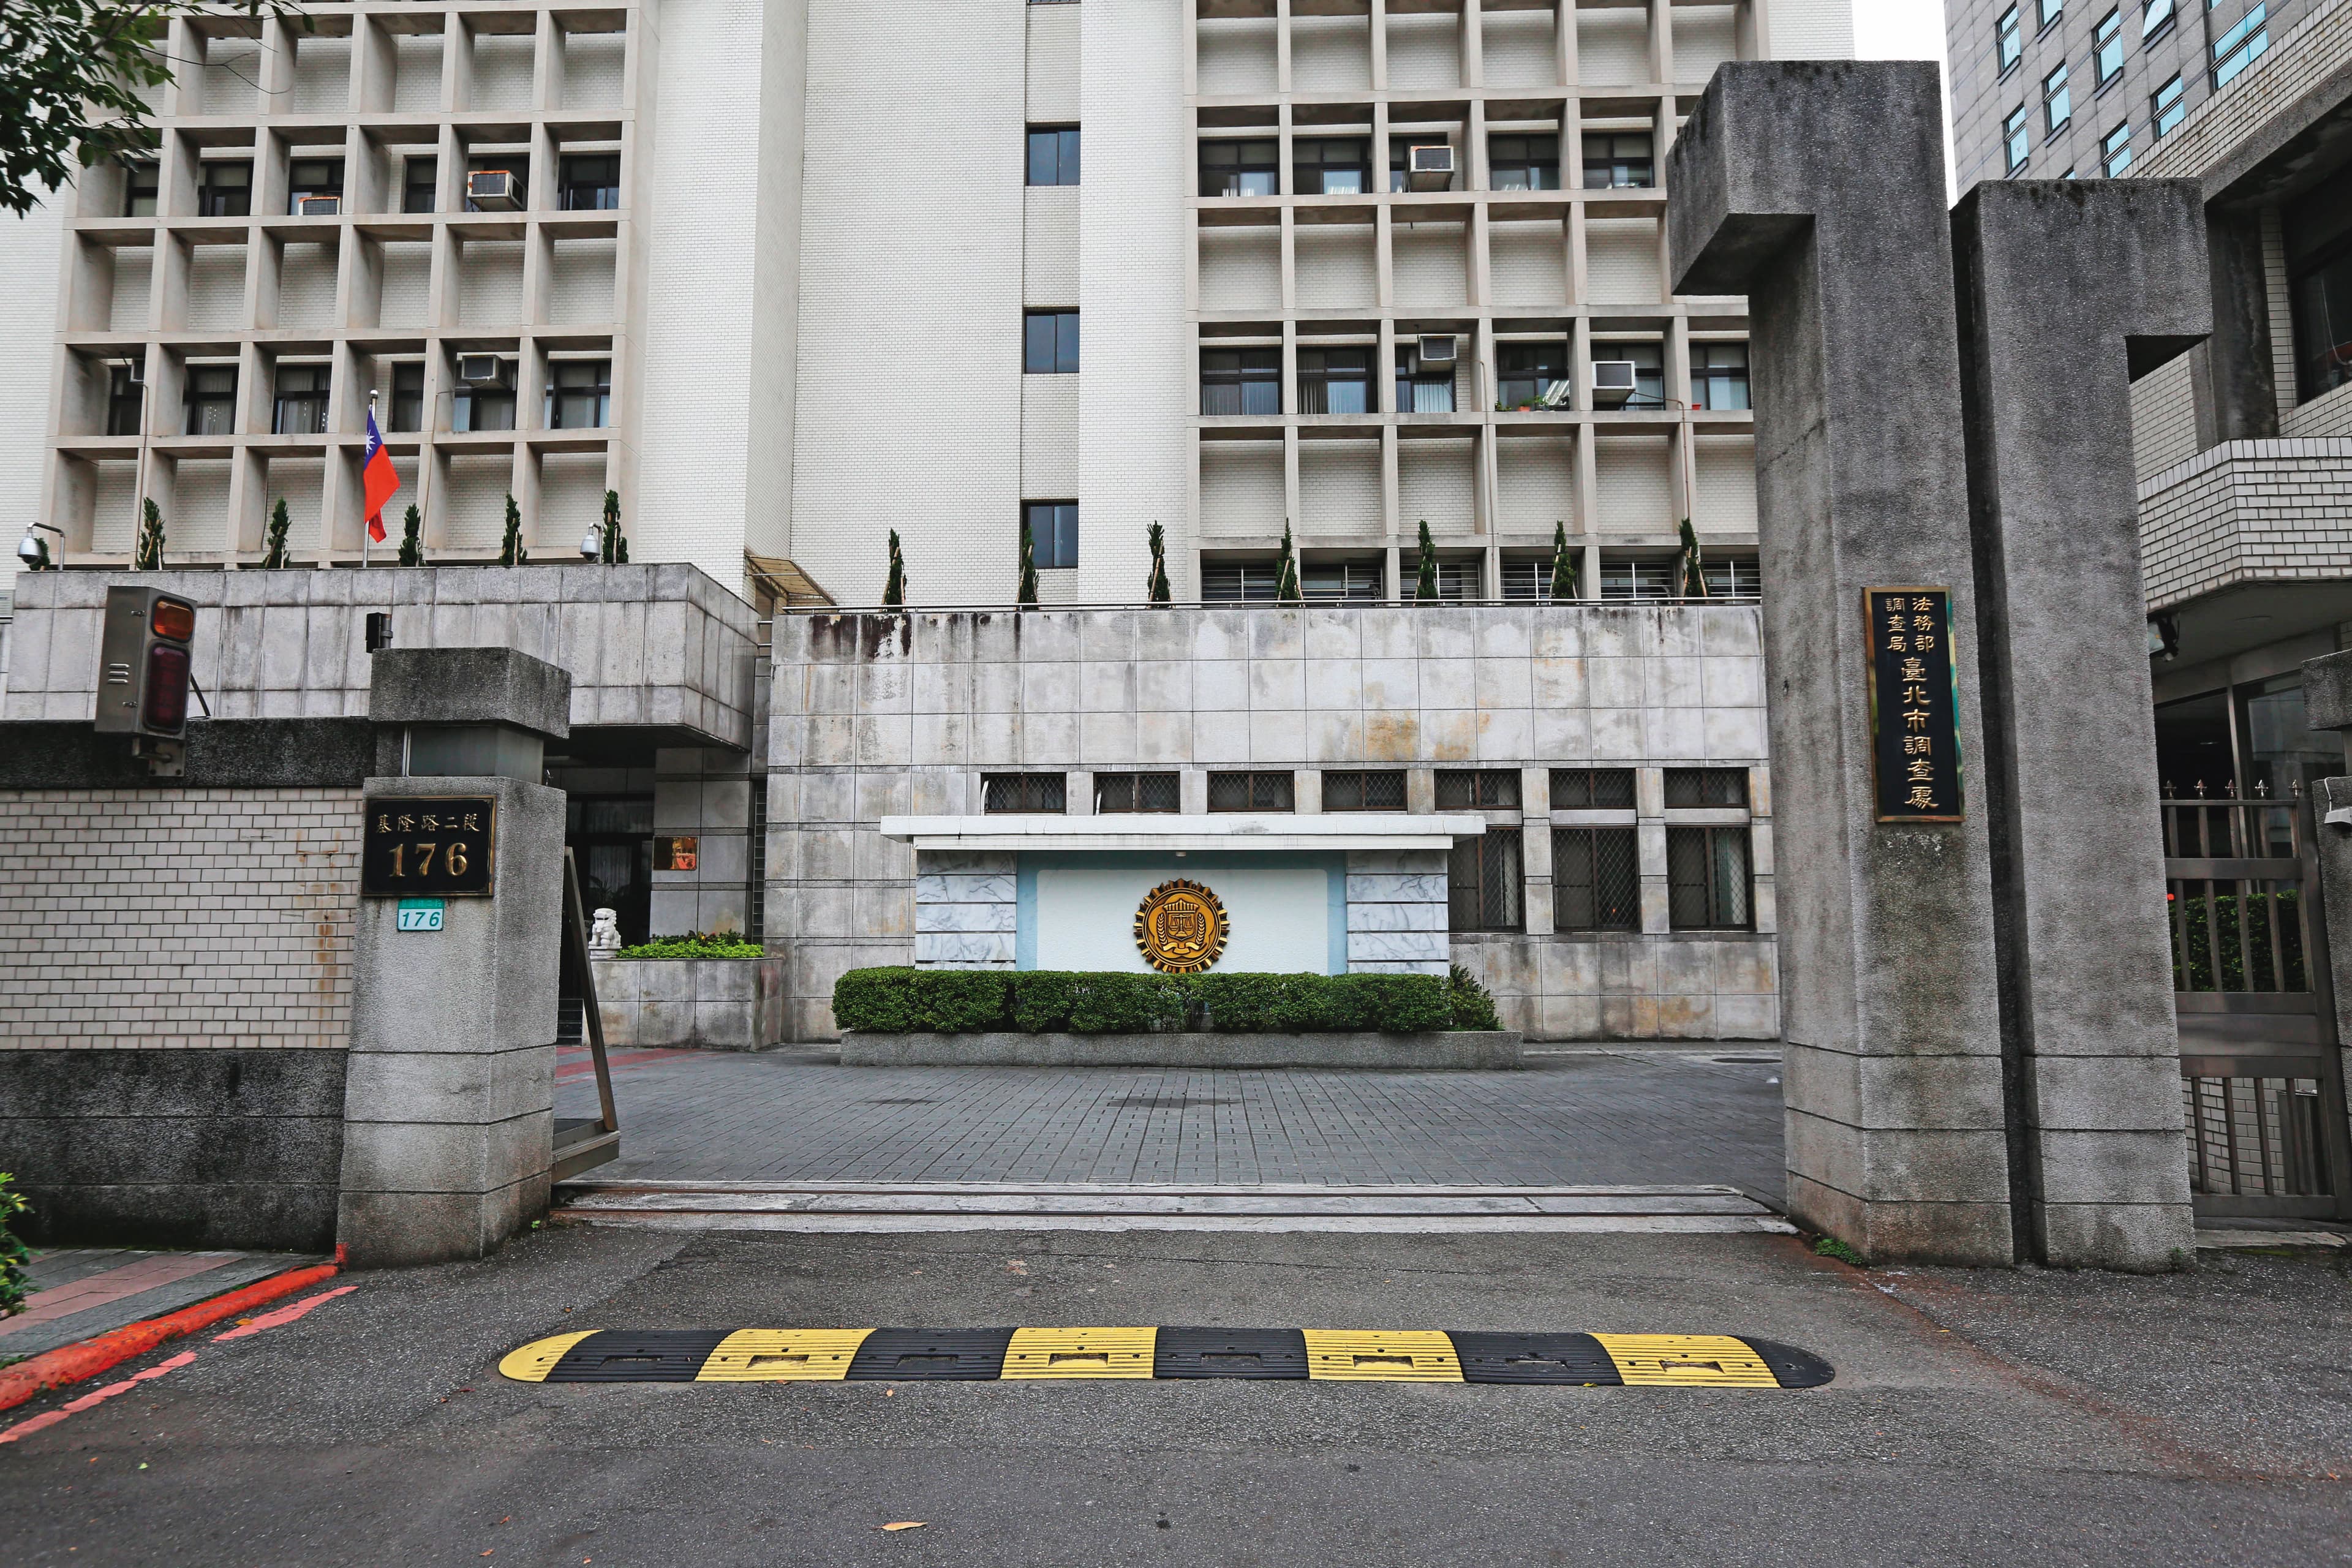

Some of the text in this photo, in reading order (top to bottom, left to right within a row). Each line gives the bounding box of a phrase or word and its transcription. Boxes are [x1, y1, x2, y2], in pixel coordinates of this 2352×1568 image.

[1885, 597, 1907, 653] 調查局
[375, 813, 481, 834] 基隆路二段
[388, 842, 468, 878] 176
[402, 911, 441, 927] 176
